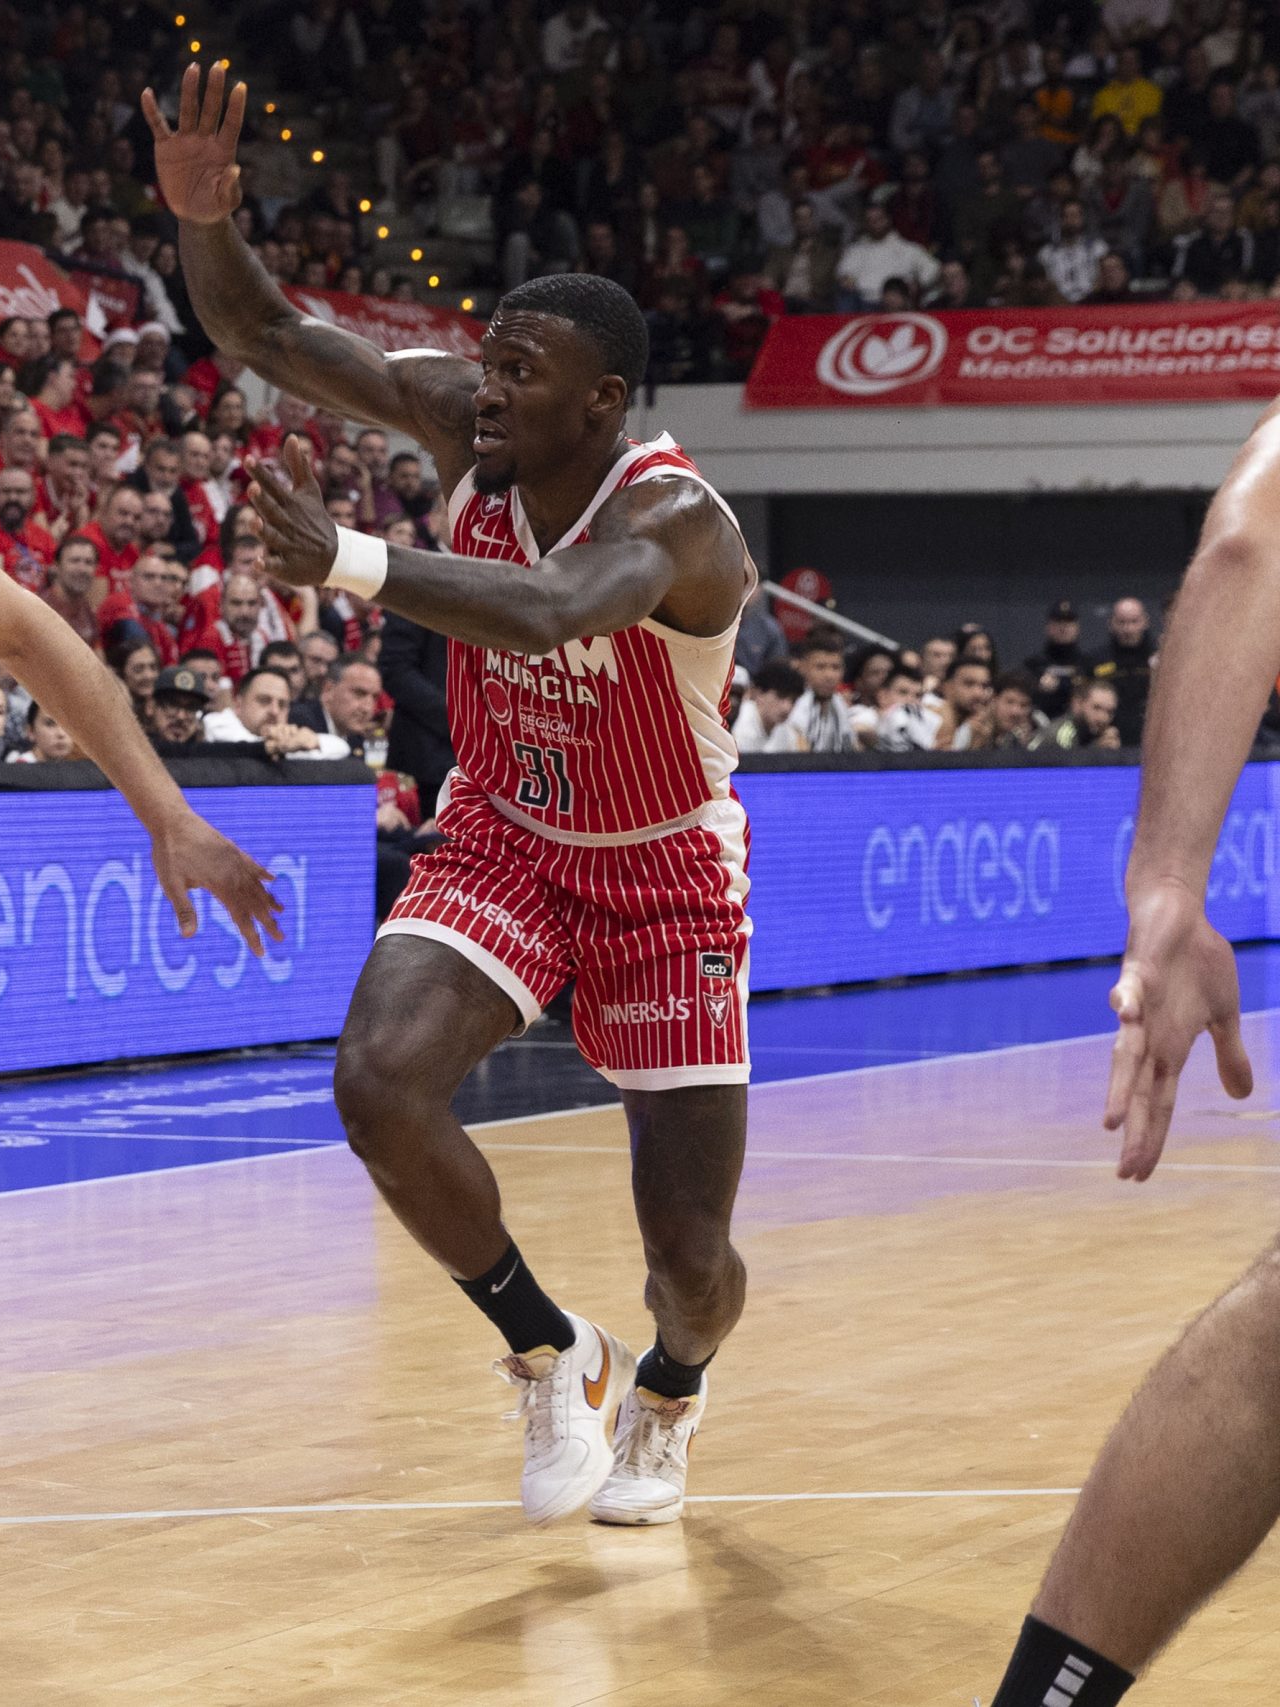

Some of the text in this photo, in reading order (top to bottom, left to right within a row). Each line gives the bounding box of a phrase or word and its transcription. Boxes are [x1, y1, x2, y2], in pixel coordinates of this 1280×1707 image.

[966, 325, 1038, 354] OC
[486, 648, 598, 708] MURCIA
[519, 712, 571, 735] REGIÓN
[520, 723, 596, 748] DE MURCIA
[514, 740, 574, 815] 31
[862, 818, 1061, 930] endesa
[442, 886, 546, 959] INVERSUS
[704, 963, 727, 975] acb
[601, 994, 691, 1025] INVERSUS
